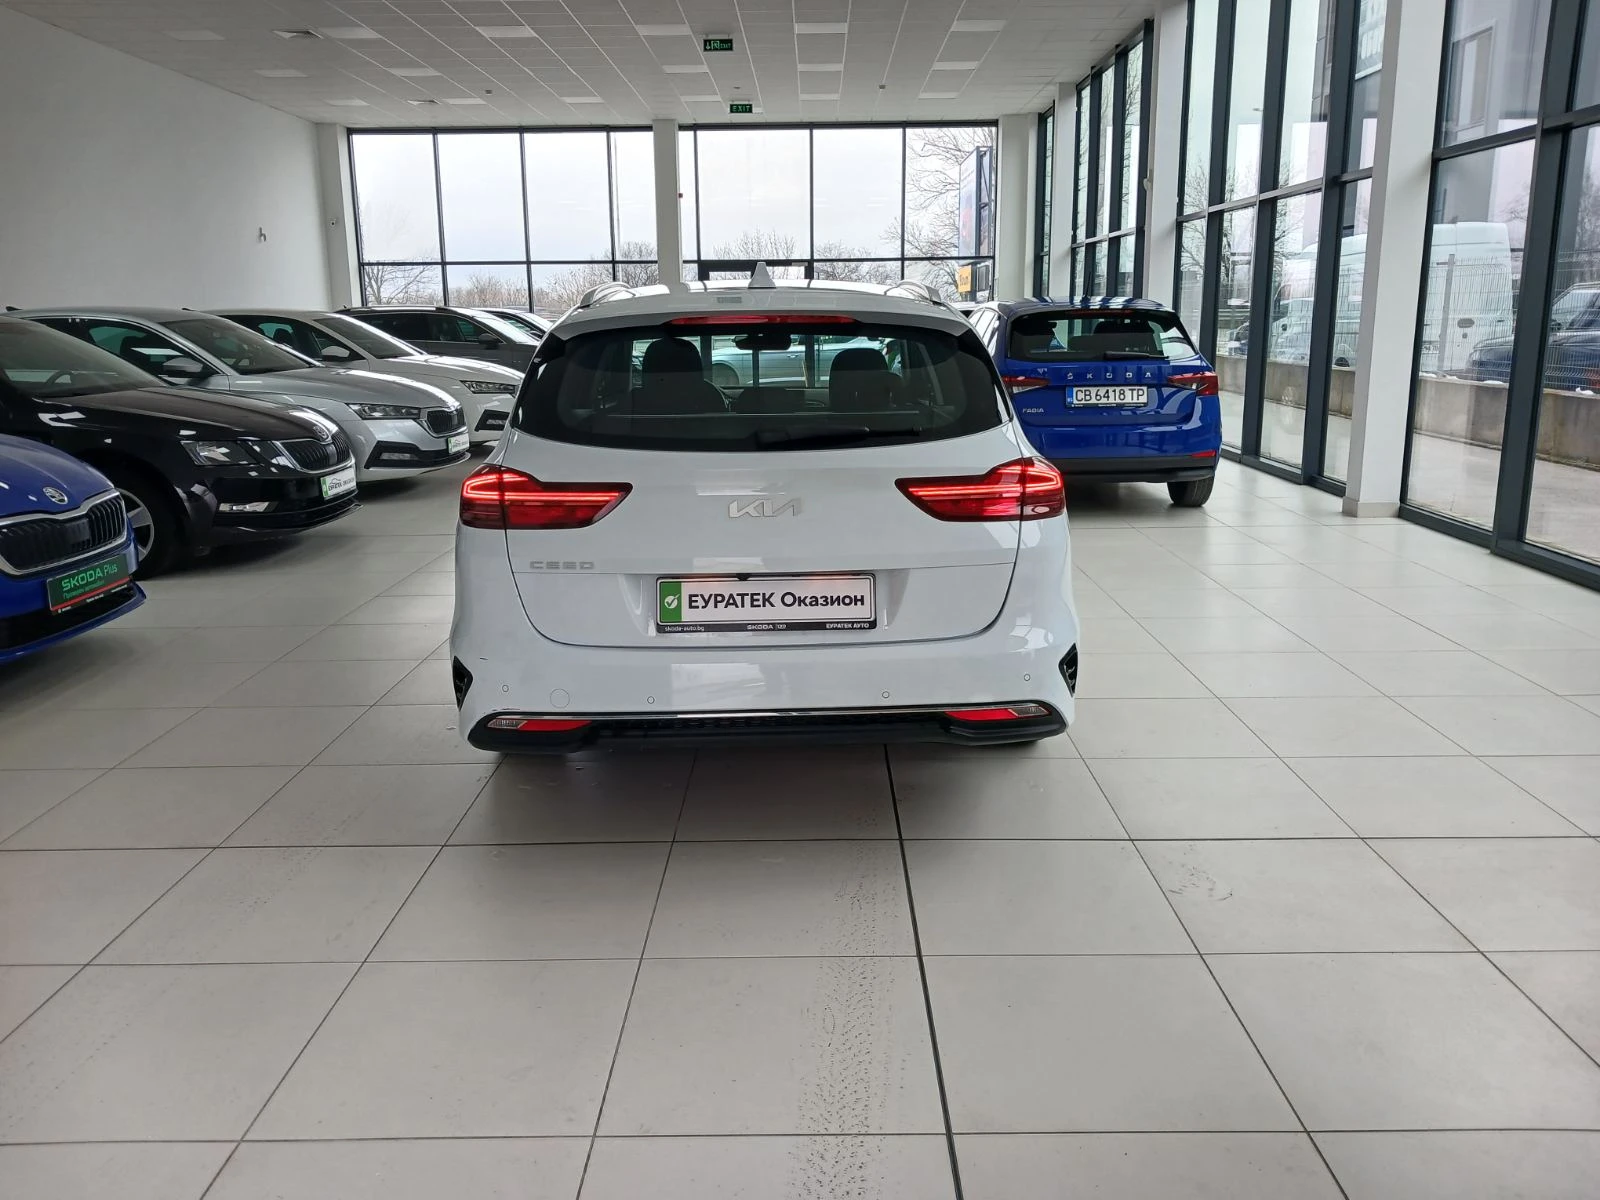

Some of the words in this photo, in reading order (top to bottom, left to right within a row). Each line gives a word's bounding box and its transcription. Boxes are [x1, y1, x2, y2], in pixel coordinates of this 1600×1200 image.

[1094, 388, 1126, 402] 6418
[728, 497, 802, 519] KIA
[104, 563, 118, 576] Plus
[529, 560, 595, 570] CEED
[688, 591, 776, 610] ЕУРАТЕК
[780, 590, 866, 608] Оказион
